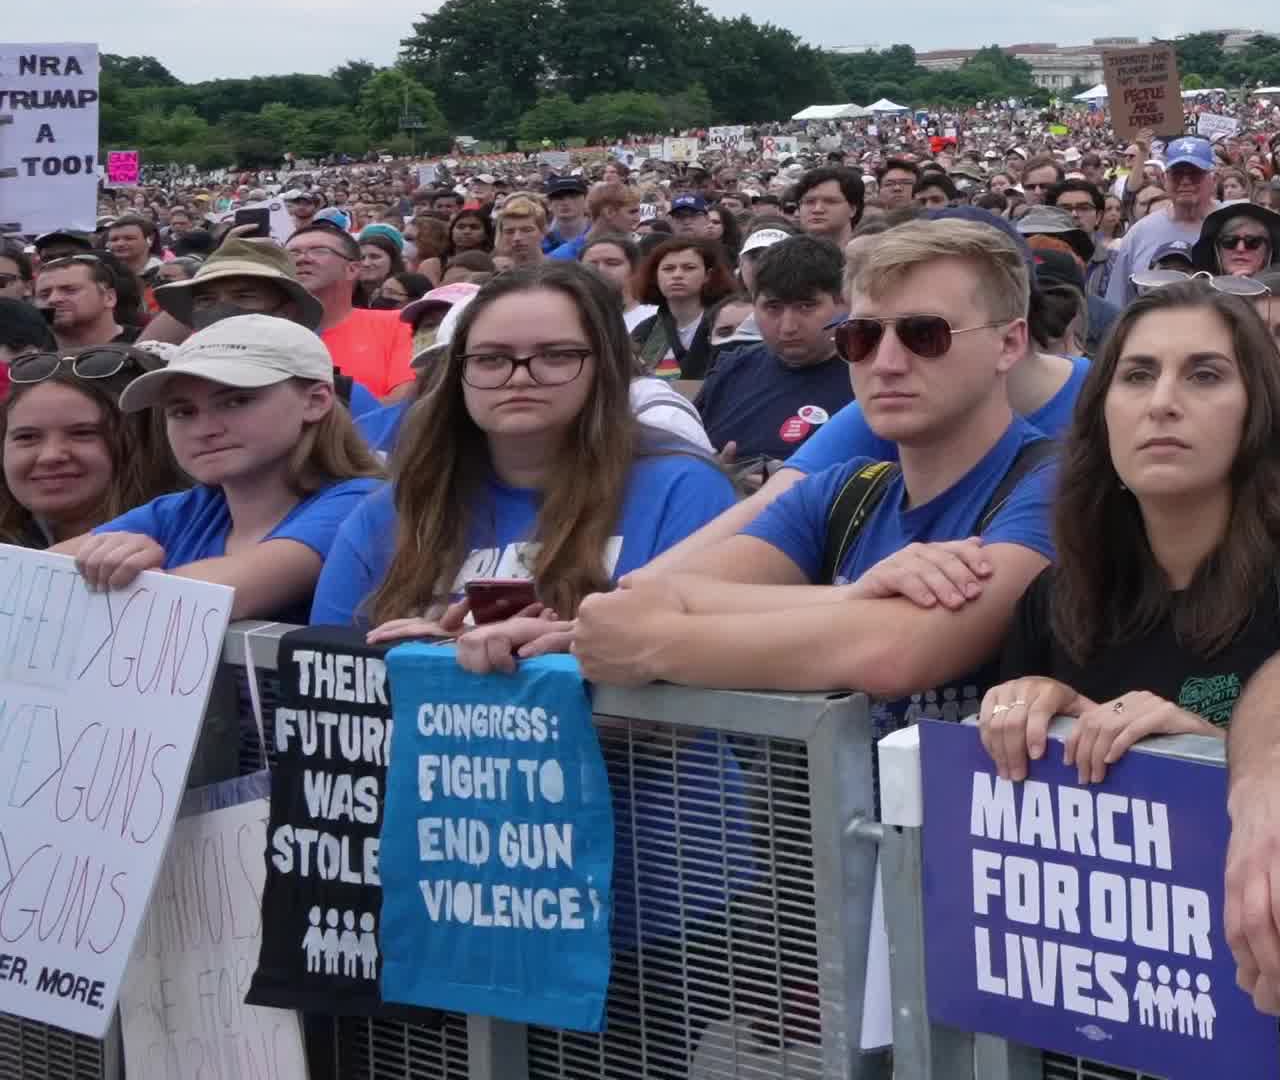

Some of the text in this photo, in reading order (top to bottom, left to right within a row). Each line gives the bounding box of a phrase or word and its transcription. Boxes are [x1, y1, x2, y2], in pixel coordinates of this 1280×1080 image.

[19, 54, 84, 76] NRA
[35, 123, 56, 143] A
[21, 155, 94, 176] TOO!
[108, 588, 219, 697] GUNS
[293, 650, 389, 705] THEIR
[417, 703, 560, 743] CONGRESS:
[55, 722, 176, 844] GUNS
[304, 770, 380, 825] WAS
[417, 754, 565, 804] FIGHT TO
[417, 817, 574, 870] END GUN
[970, 771, 1173, 871] MARCH
[0, 844, 128, 954] GUNS
[418, 878, 586, 930] VIOLENCE
[972, 848, 1213, 961] FOR OUR
[36, 966, 106, 1011] MORE.
[974, 925, 1131, 1024] LIVES
